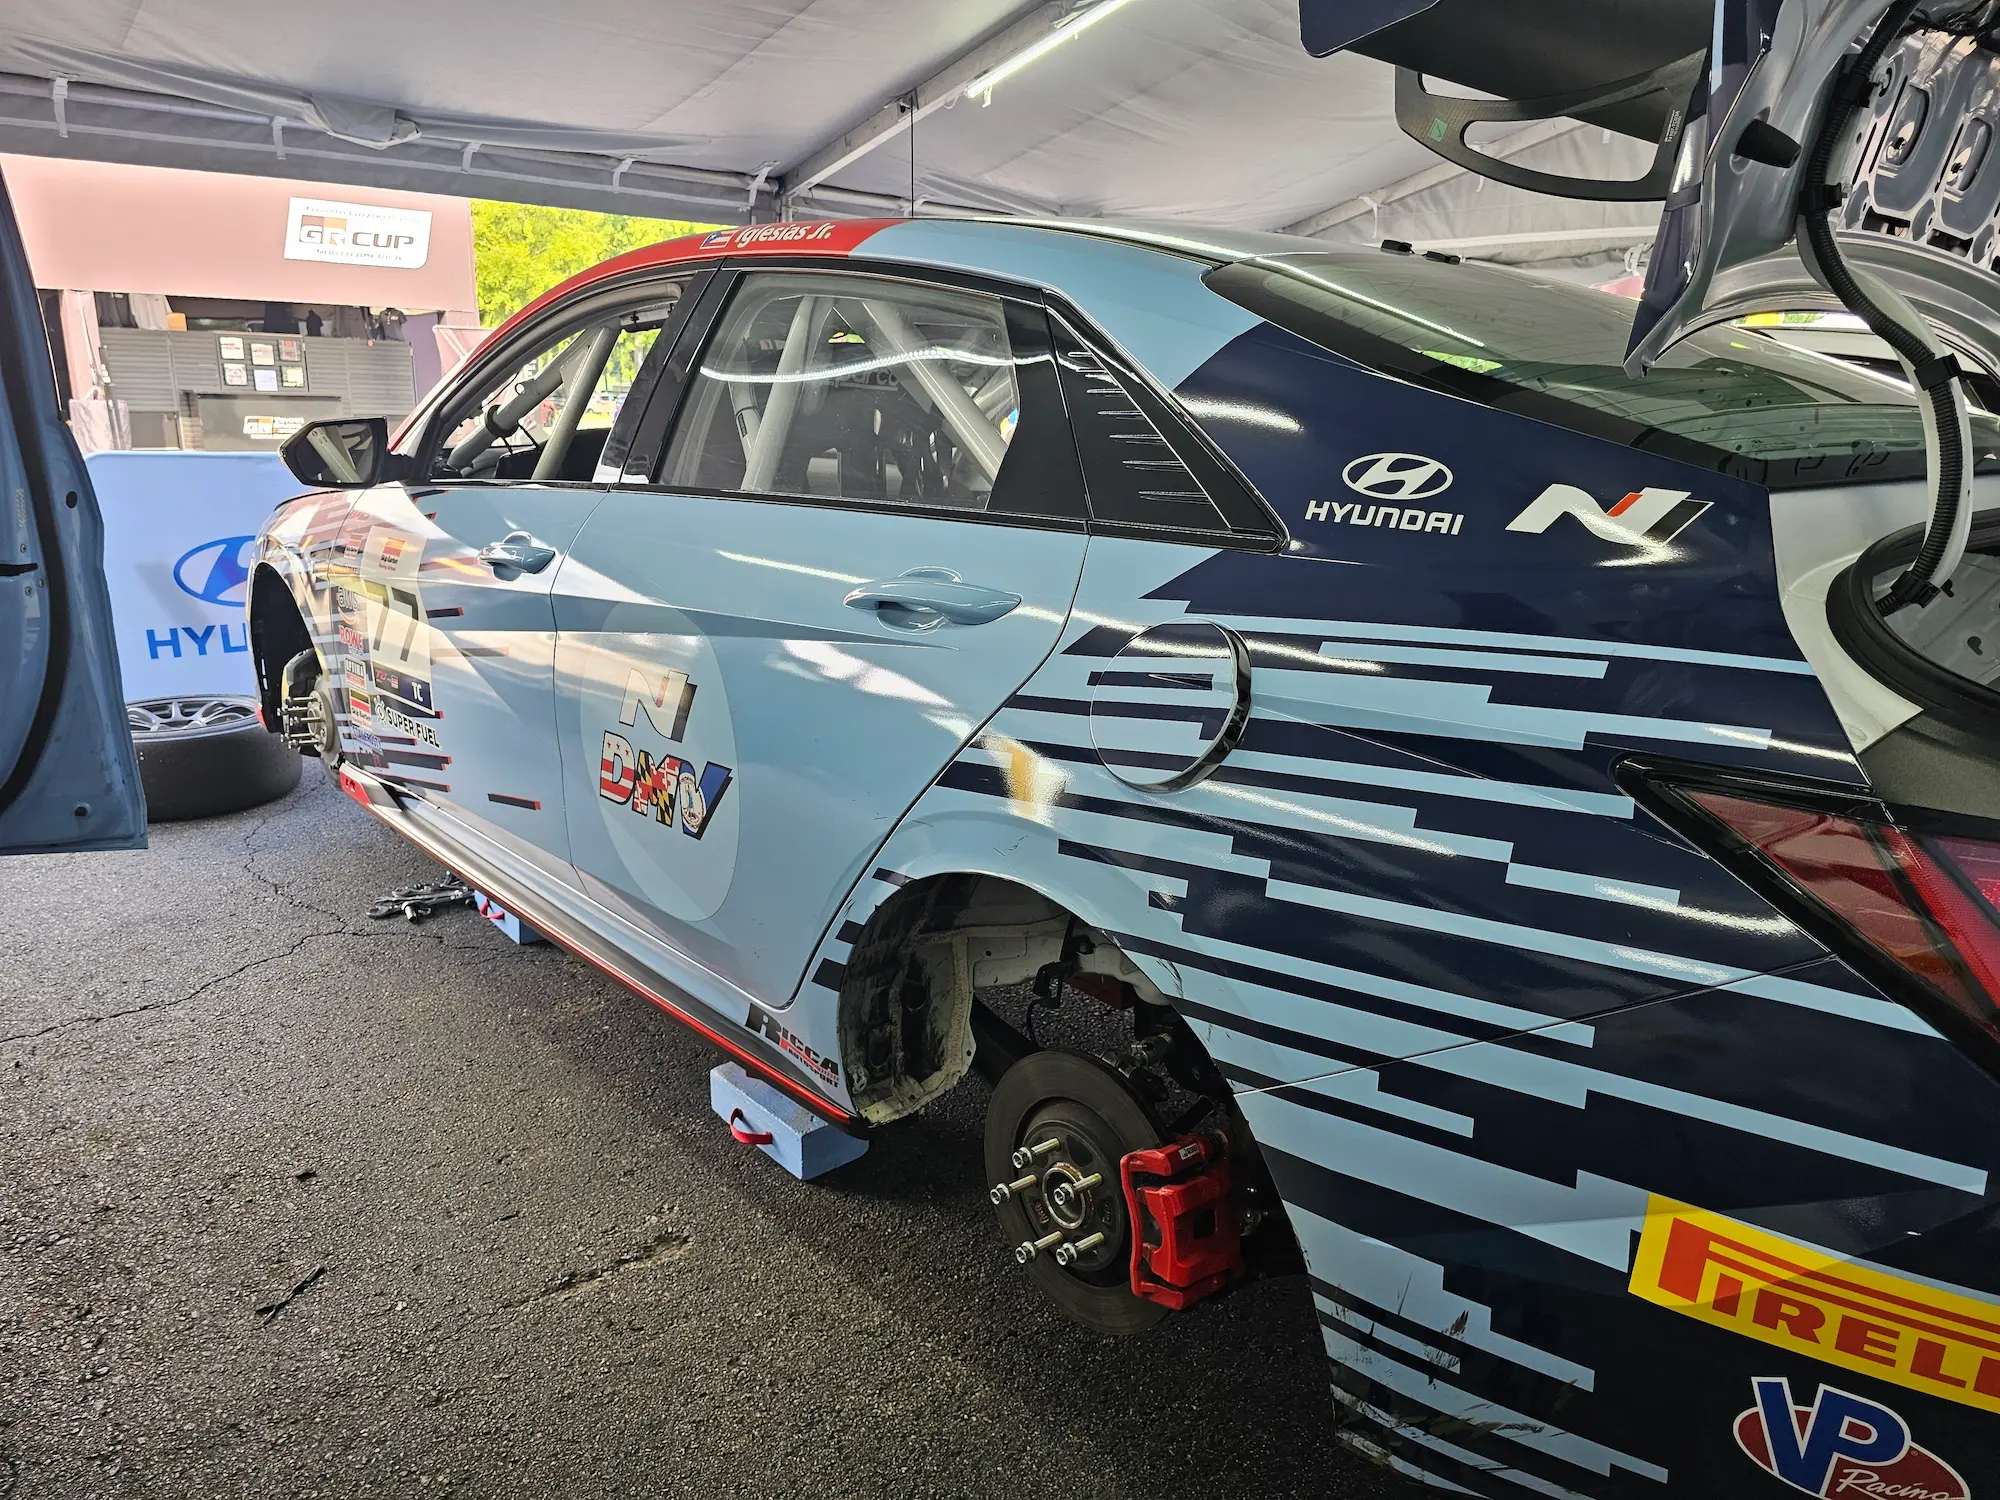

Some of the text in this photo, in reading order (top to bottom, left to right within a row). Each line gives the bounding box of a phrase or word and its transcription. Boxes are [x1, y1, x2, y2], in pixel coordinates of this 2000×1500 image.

[352, 231, 415, 250] CUP
[735, 222, 836, 248] Iglesias Jr.
[1304, 500, 1464, 536] HYUNDAI
[338, 624, 364, 650] ROWE
[364, 580, 419, 662] 77
[411, 681, 425, 702] TC
[619, 668, 698, 743] N
[386, 708, 415, 737] SUPER
[415, 721, 441, 749] FUEL
[600, 730, 733, 841] DMV
[744, 1002, 839, 1076] RICCA
[788, 1048, 840, 1088] AUTOSPORT
[1751, 1376, 1912, 1498] VP
